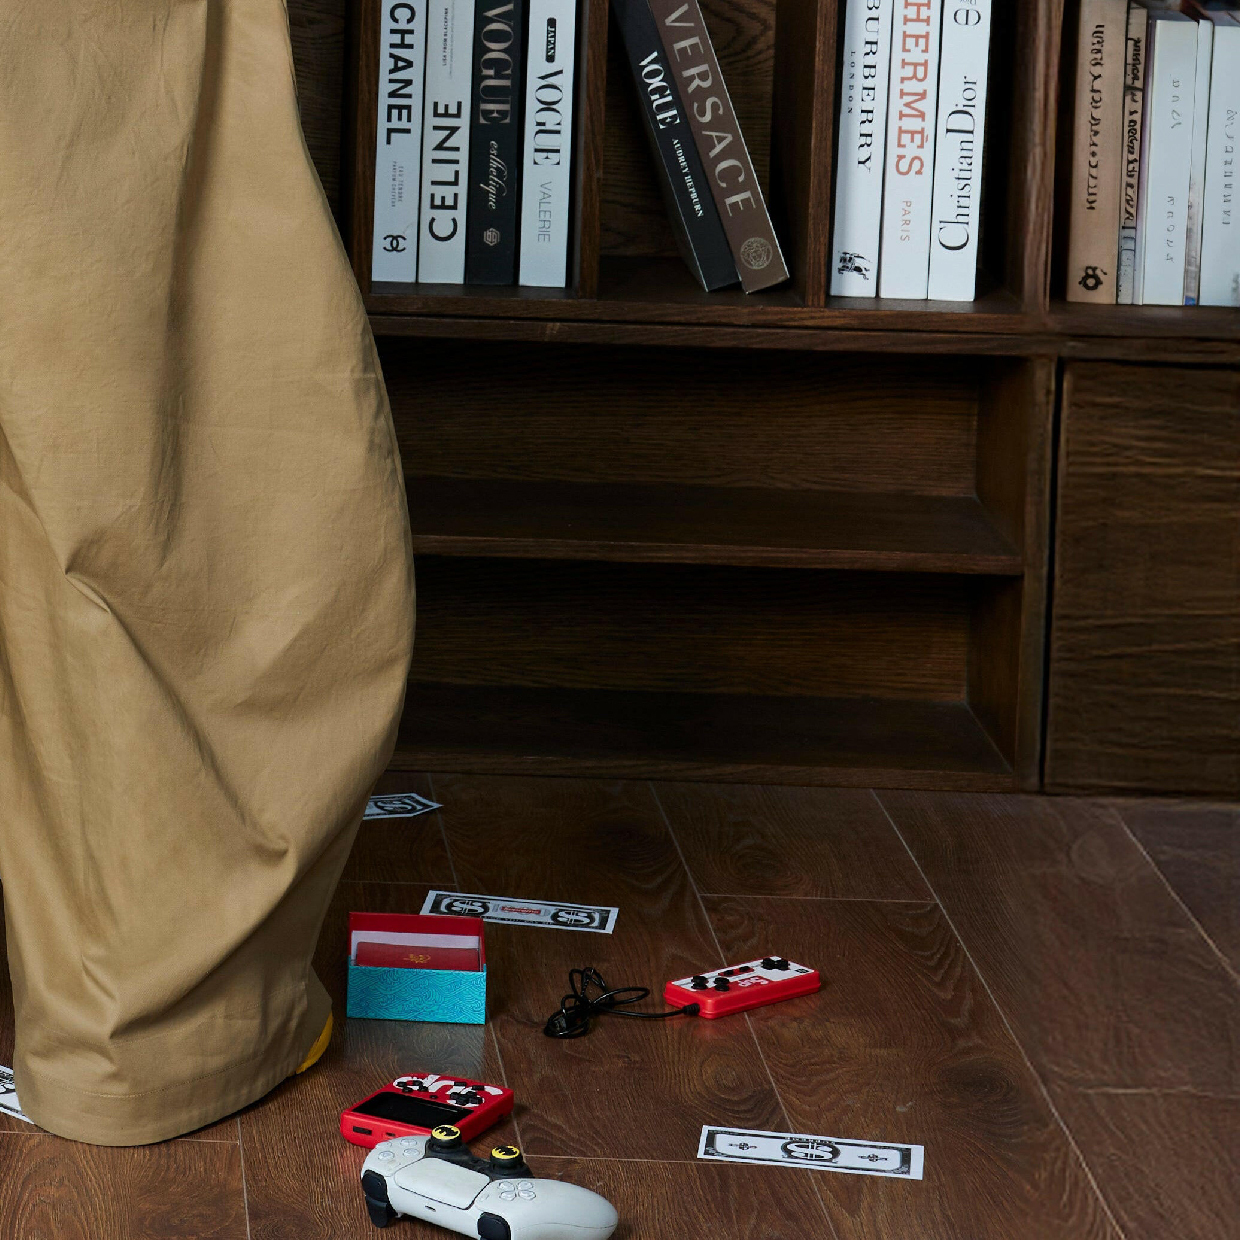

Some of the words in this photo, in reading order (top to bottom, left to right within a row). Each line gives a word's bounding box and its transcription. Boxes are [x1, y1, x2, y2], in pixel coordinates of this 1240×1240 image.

[385, 2, 417, 145] CHANEL
[479, 2, 515, 124] VOGUE
[547, 25, 555, 57] JAPAN
[847, 50, 855, 114] LONDON
[533, 69, 564, 166] VOGUE
[638, 51, 680, 130] VOGUE
[671, 138, 691, 173] AUDREY
[684, 175, 704, 218] HEPBURN
[664, 3, 756, 217] VERSACE
[428, 100, 462, 242] CELINE
[537, 181, 552, 243] VALERIE
[900, 200, 911, 242] PARIS
